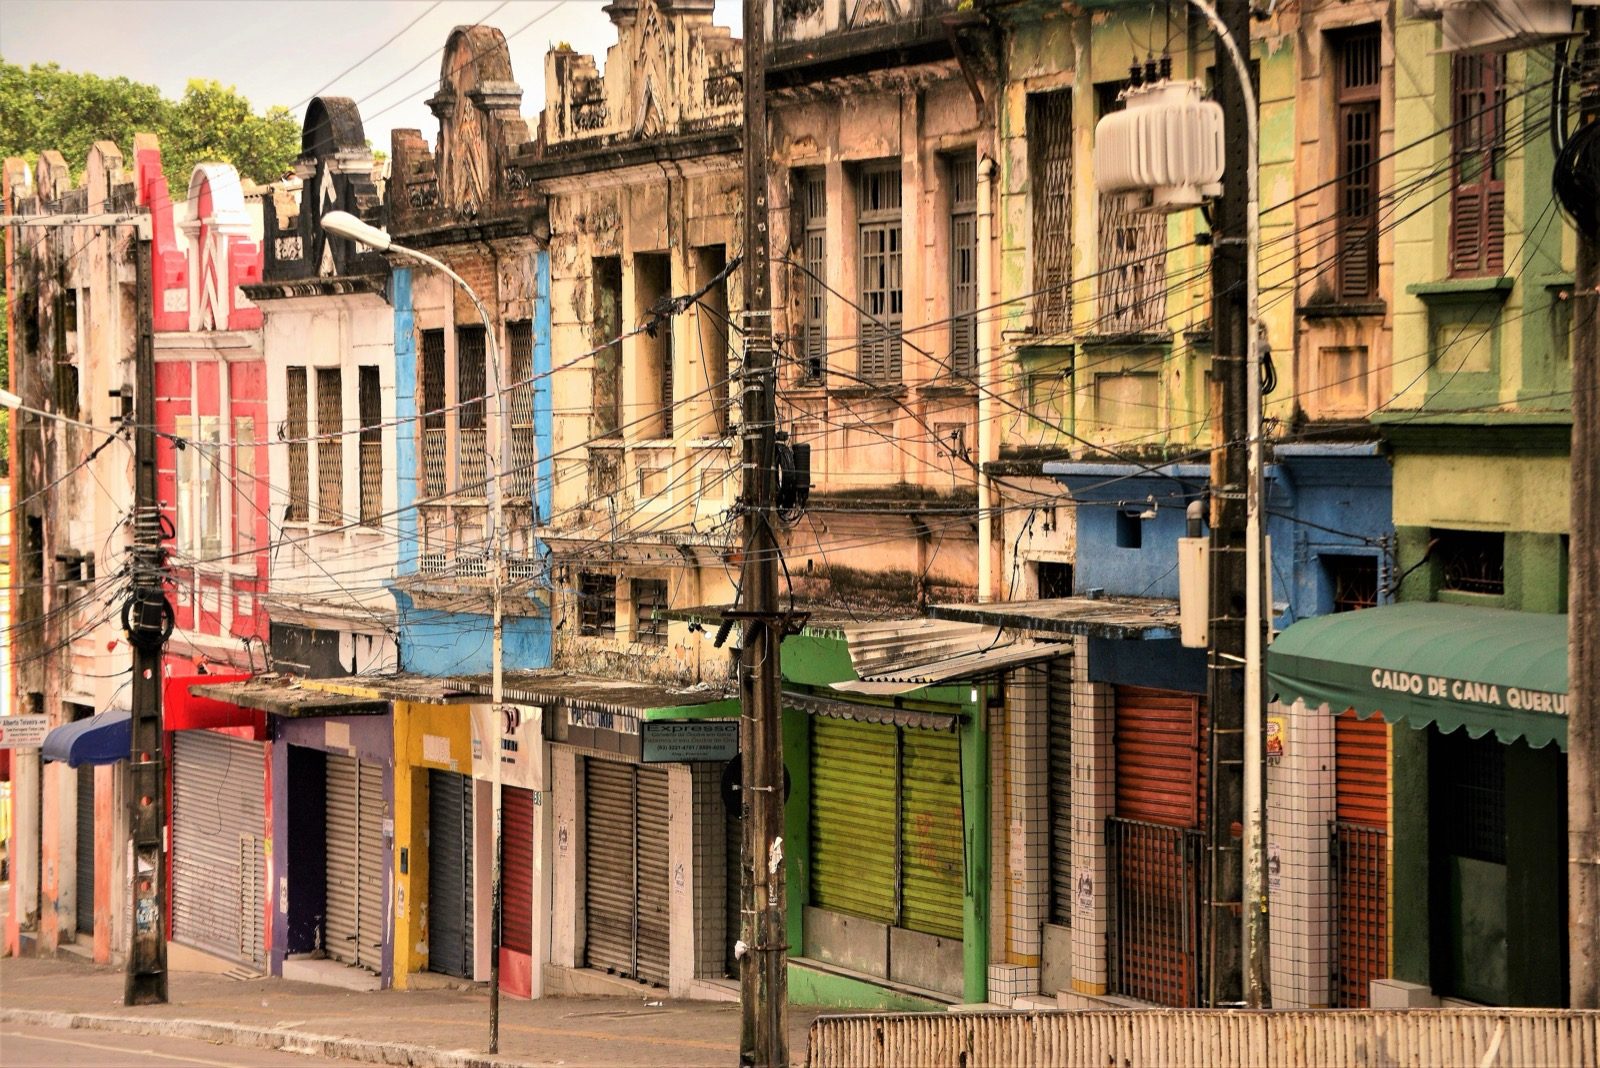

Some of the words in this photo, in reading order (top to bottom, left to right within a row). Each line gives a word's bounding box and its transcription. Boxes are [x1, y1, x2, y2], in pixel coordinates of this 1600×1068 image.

[1371, 668, 1423, 695] CALDO
[1428, 676, 1447, 698] DE
[1452, 680, 1501, 705] CANA
[1506, 687, 1569, 715] QUERU
[647, 724, 737, 733] Expresso
